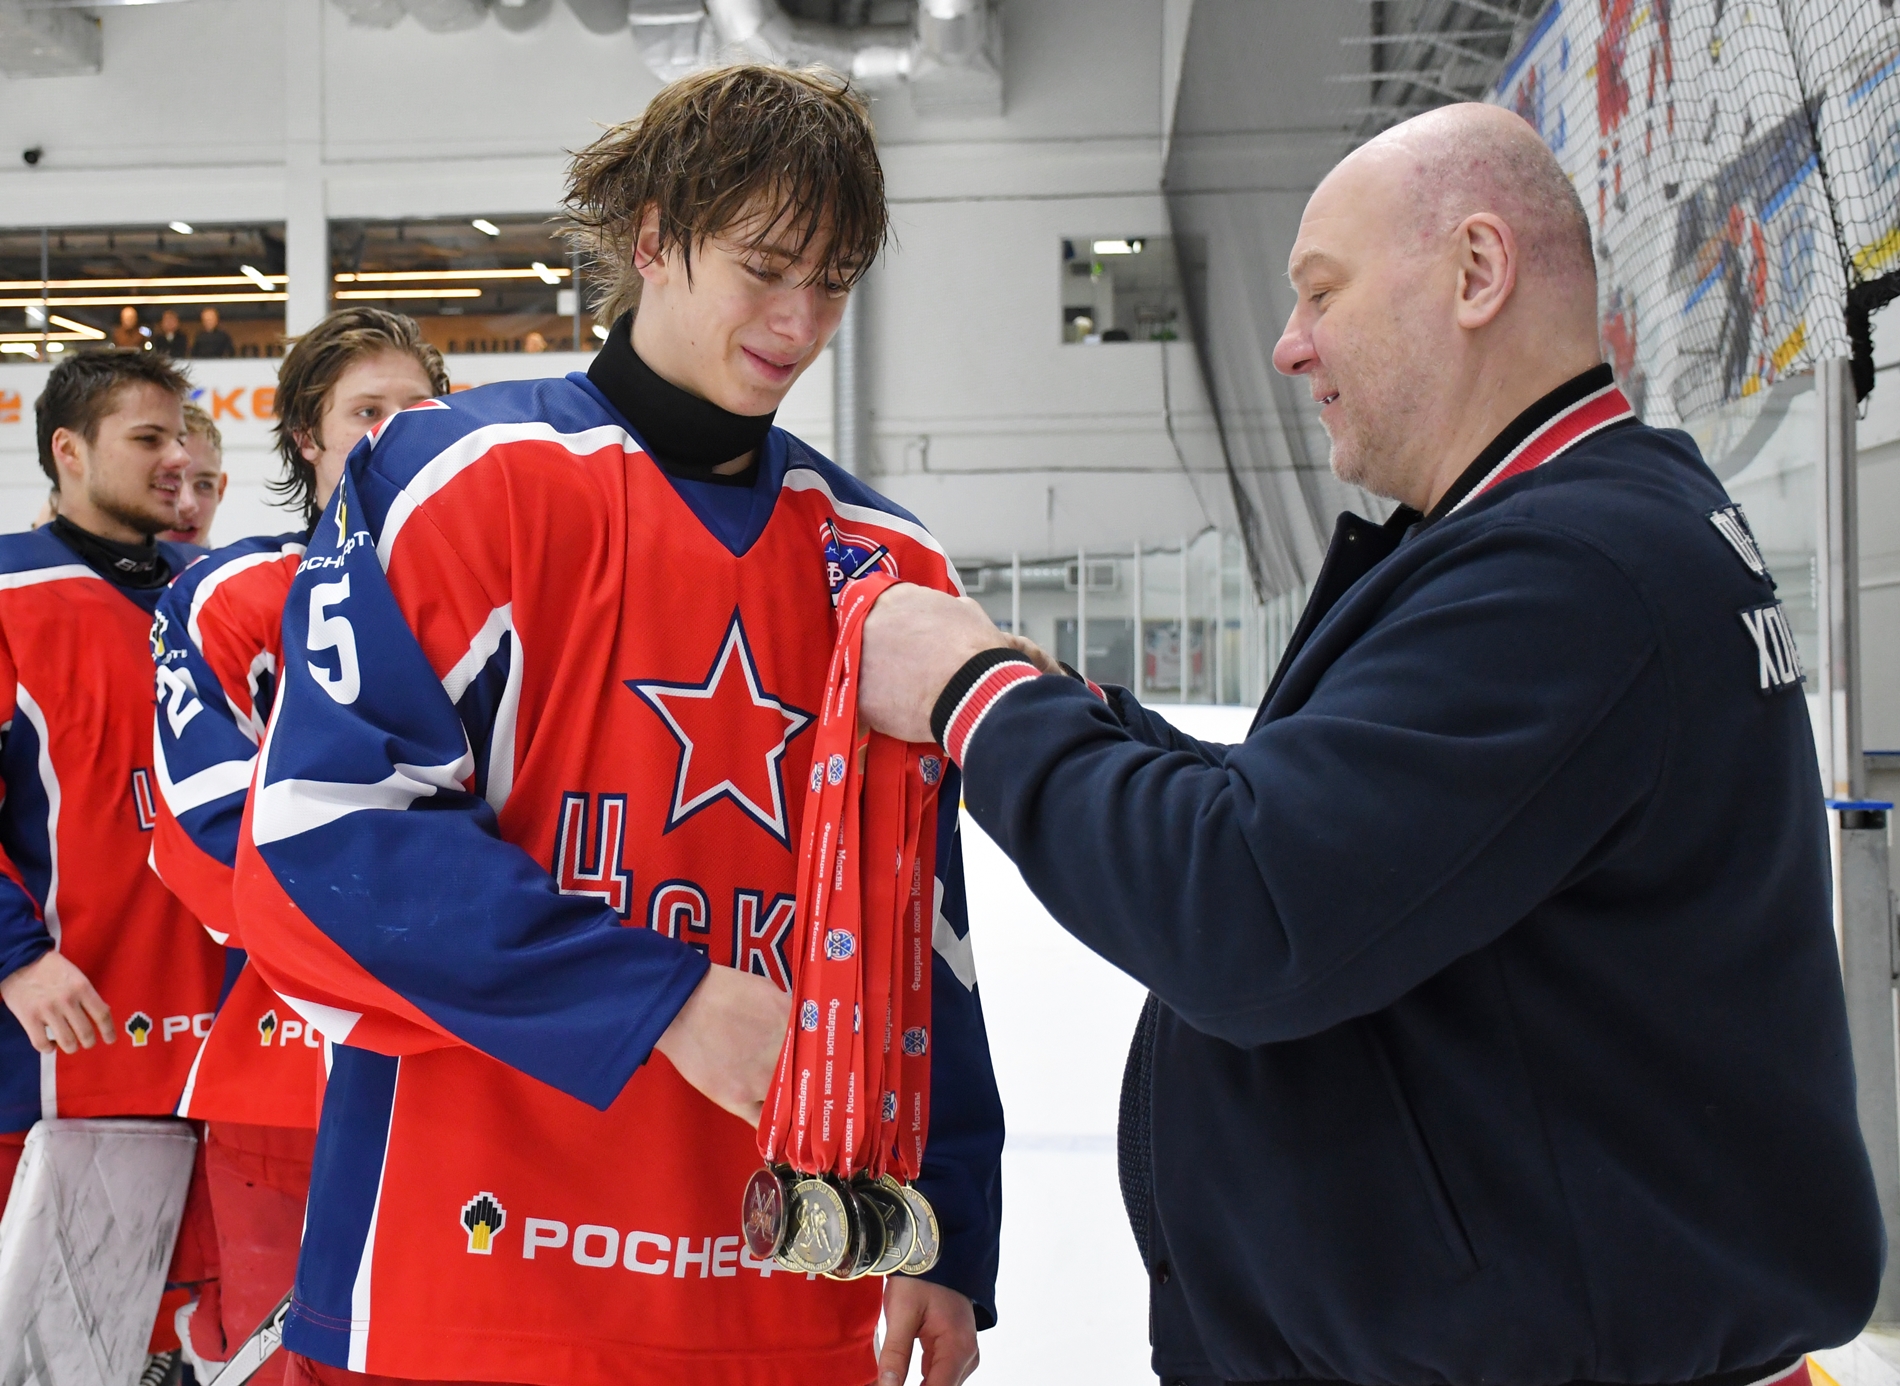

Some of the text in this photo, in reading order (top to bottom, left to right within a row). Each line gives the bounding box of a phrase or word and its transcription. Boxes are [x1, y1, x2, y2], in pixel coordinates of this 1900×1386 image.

[307, 572, 361, 705] 5
[811, 822, 832, 962] Федерация хоккея Москвы
[835, 850, 846, 891] Москвы
[911, 857, 923, 991] Федерация хоккея Москвы
[798, 1069, 811, 1126] Федерация
[821, 998, 840, 1142] Федерация хоккея Москвы
[912, 1092, 921, 1132] Москвы
[846, 1118, 854, 1153] хоккея
